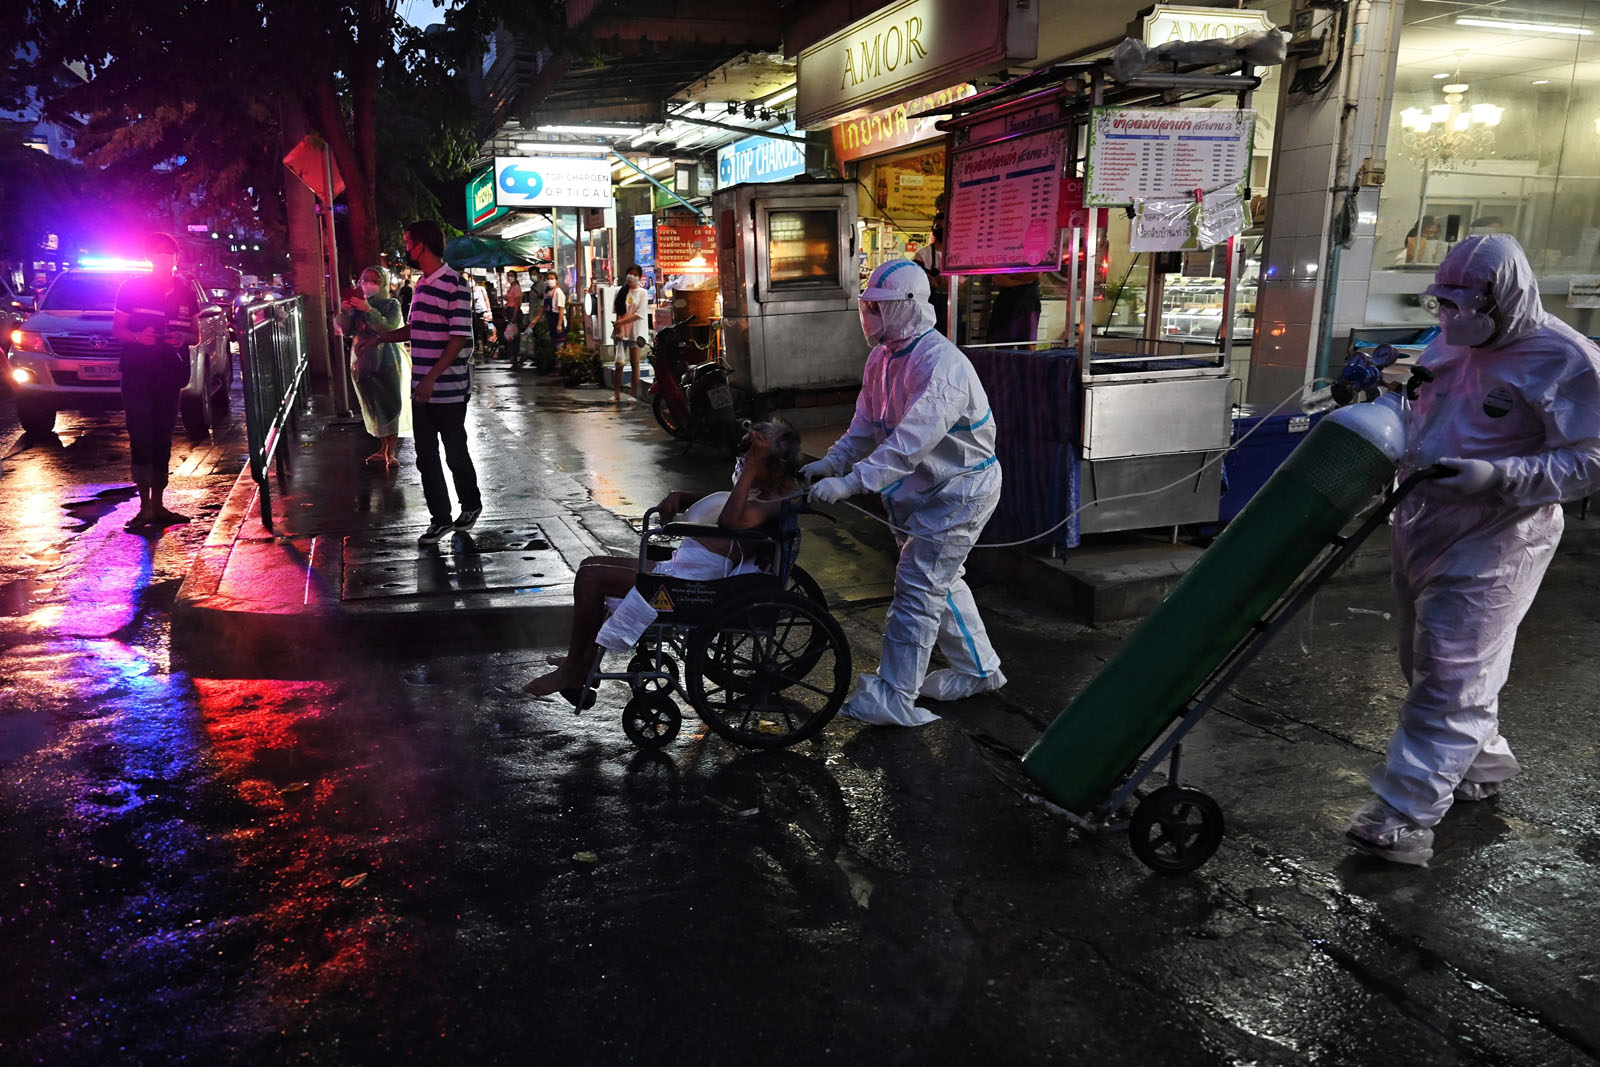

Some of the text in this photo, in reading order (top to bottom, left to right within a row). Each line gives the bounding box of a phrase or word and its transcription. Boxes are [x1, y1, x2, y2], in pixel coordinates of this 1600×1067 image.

[840, 16, 929, 91] AMOR
[1225, 121, 1233, 131] 3
[735, 147, 754, 181] TOP
[545, 173, 609, 182] TOP CHAROEN
[545, 187, 609, 198] OPTICAL
